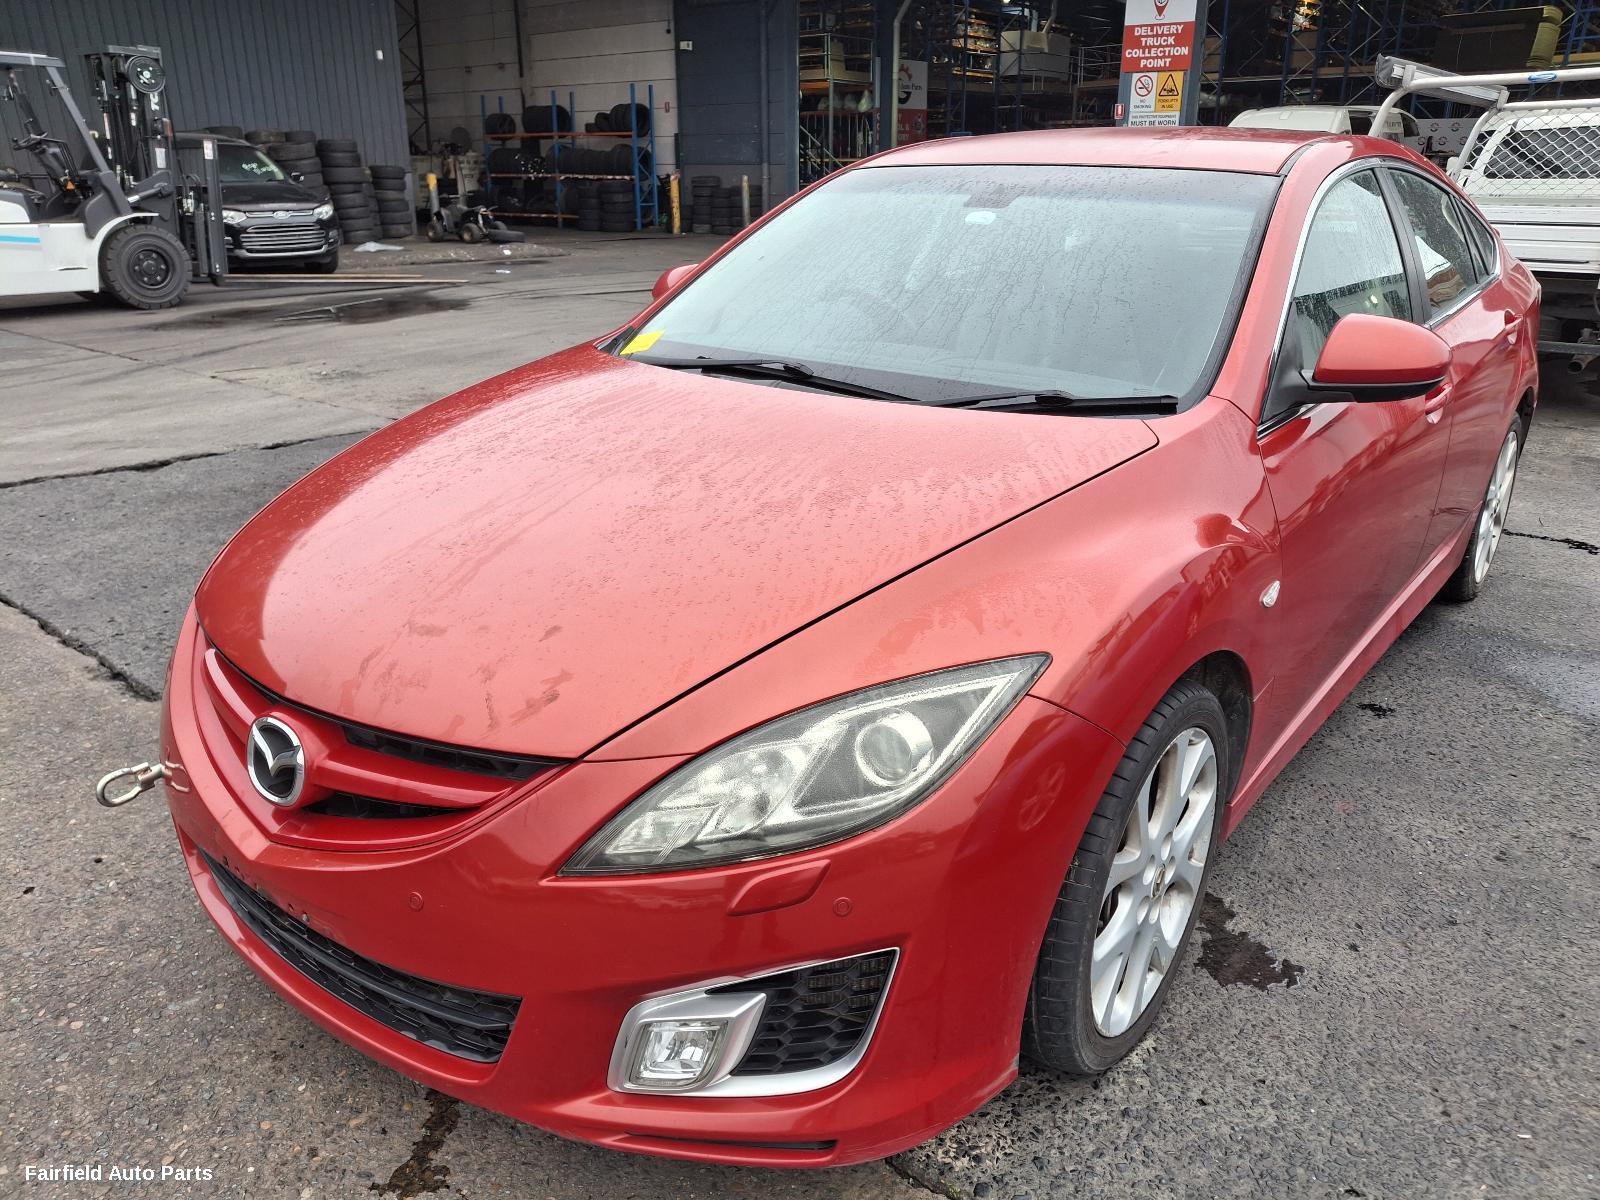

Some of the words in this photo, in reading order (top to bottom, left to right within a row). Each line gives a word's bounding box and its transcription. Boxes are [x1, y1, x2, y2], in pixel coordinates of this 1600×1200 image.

[1134, 25, 1184, 36] DELIVERY
[1141, 36, 1175, 46] TRUCK
[1125, 47, 1189, 58] COLLECTION
[1140, 58, 1171, 68] POINT
[149, 92, 159, 110] TC
